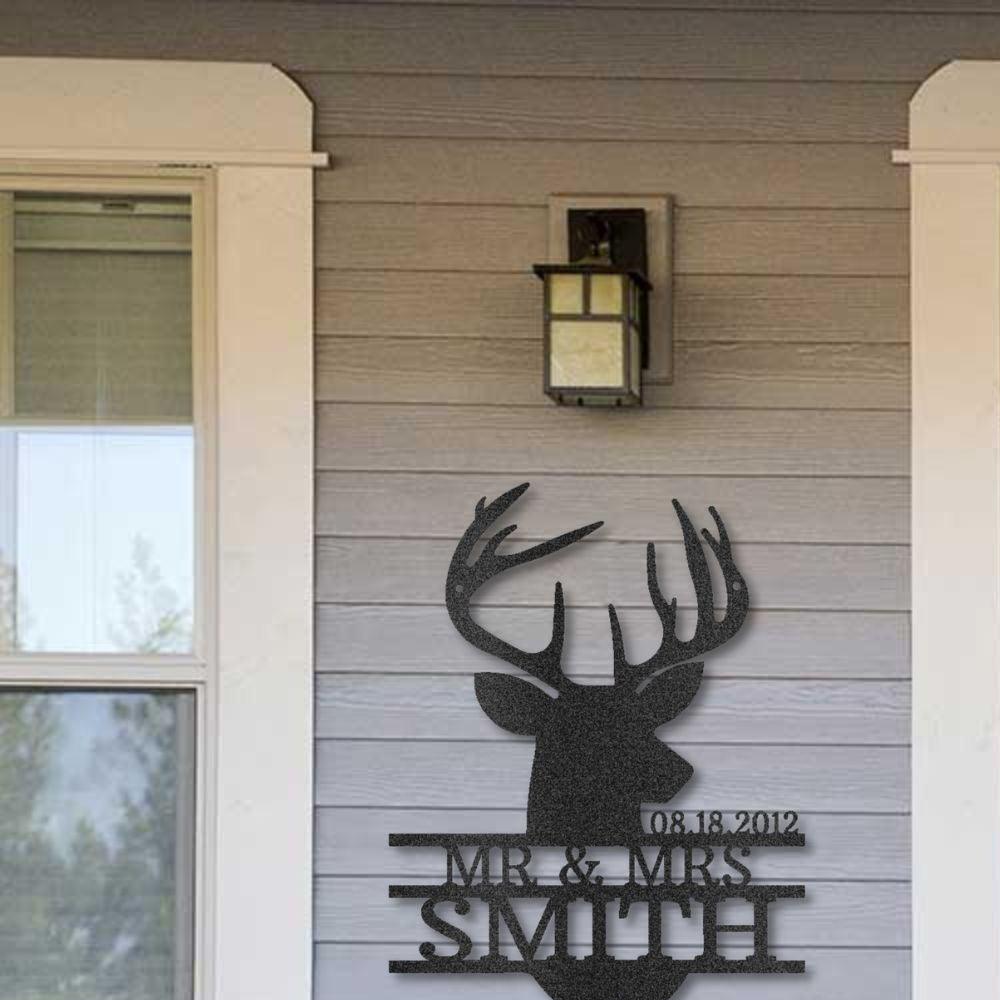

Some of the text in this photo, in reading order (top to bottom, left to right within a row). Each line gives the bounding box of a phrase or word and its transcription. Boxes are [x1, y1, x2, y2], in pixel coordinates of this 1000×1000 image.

[649, 811, 799, 835] 08.18.2012
[445, 845, 752, 887] MR & MRS
[419, 897, 777, 961] SMITH
